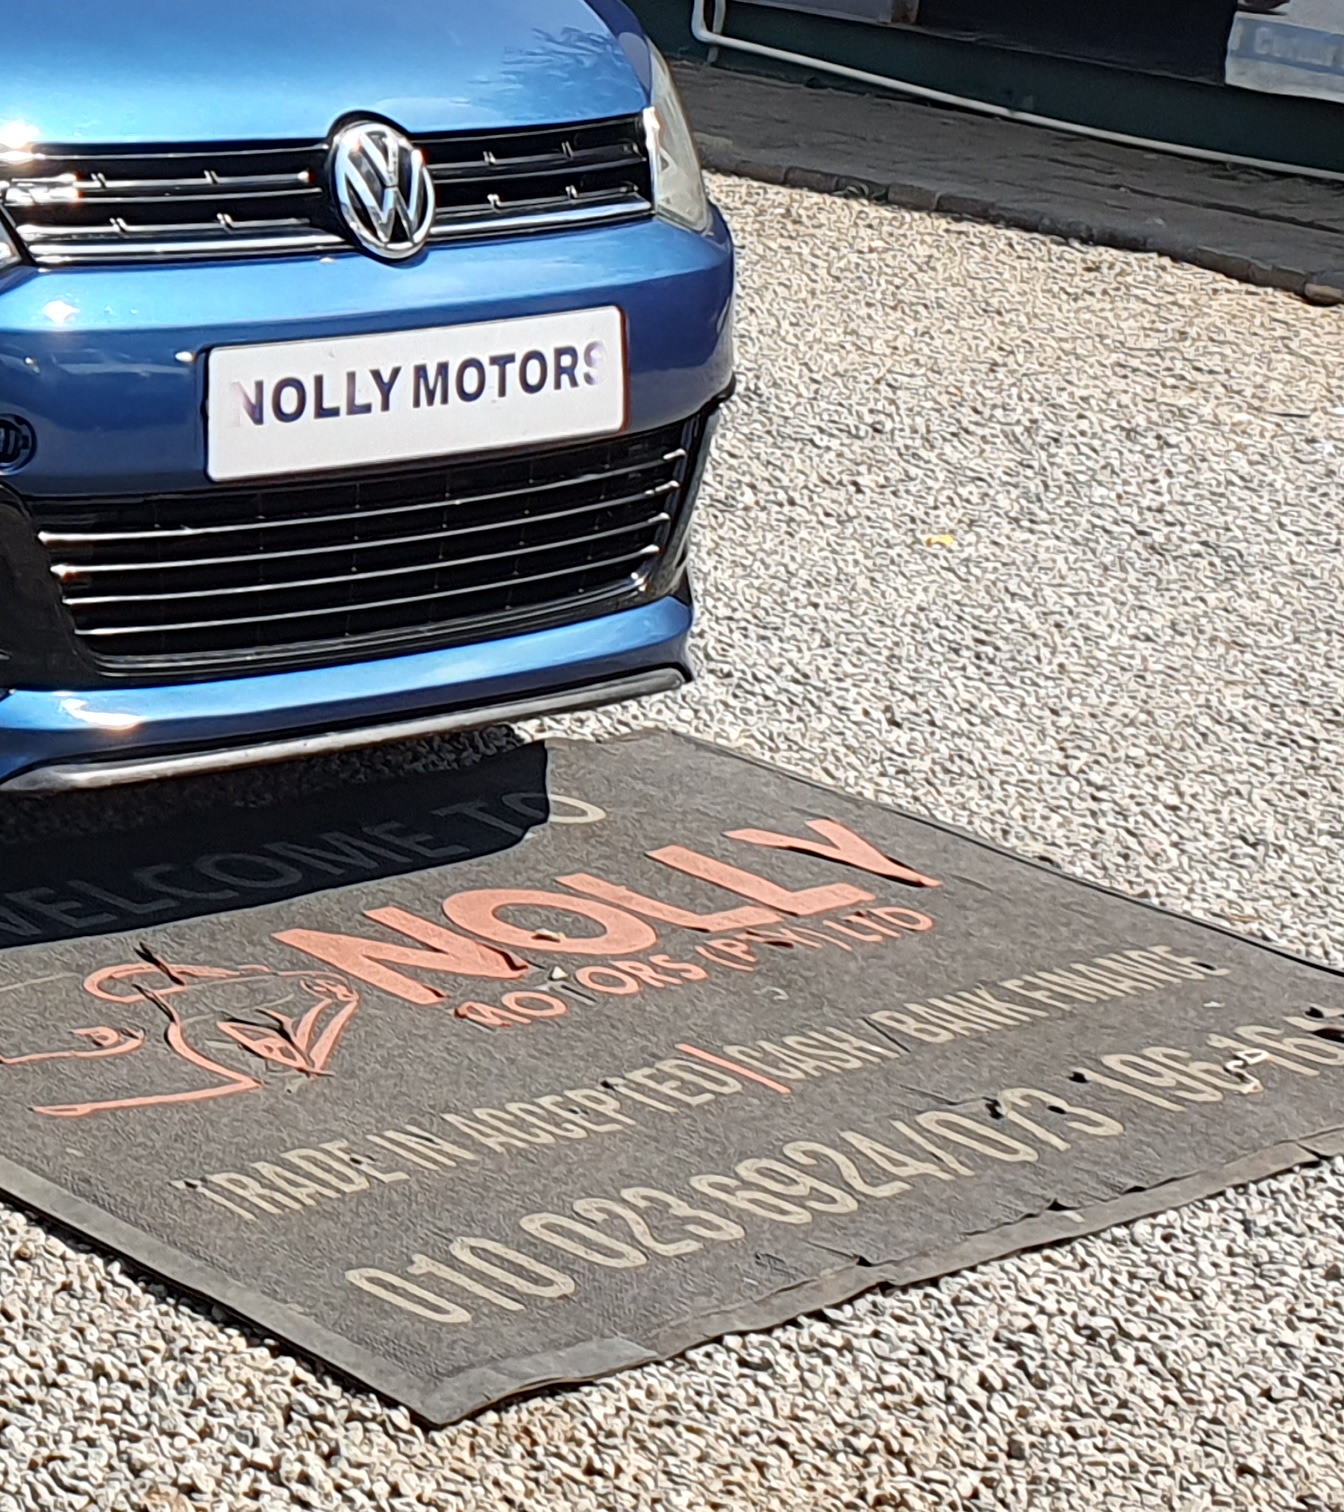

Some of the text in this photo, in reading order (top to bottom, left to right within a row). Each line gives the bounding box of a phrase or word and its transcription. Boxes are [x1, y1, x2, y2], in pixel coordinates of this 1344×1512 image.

[231, 340, 607, 426] NOLLY MOTORS
[430, 791, 608, 839] TO
[270, 817, 944, 1006] NOLLY
[168, 1138, 410, 1221] TRADE
[366, 1123, 477, 1170] IN
[439, 1058, 744, 1153] ACCEPTED
[1003, 944, 1231, 1012] FINANCE
[344, 1236, 577, 1324] 010
[519, 1187, 746, 1269] 023
[1070, 1045, 1263, 1112] 196
